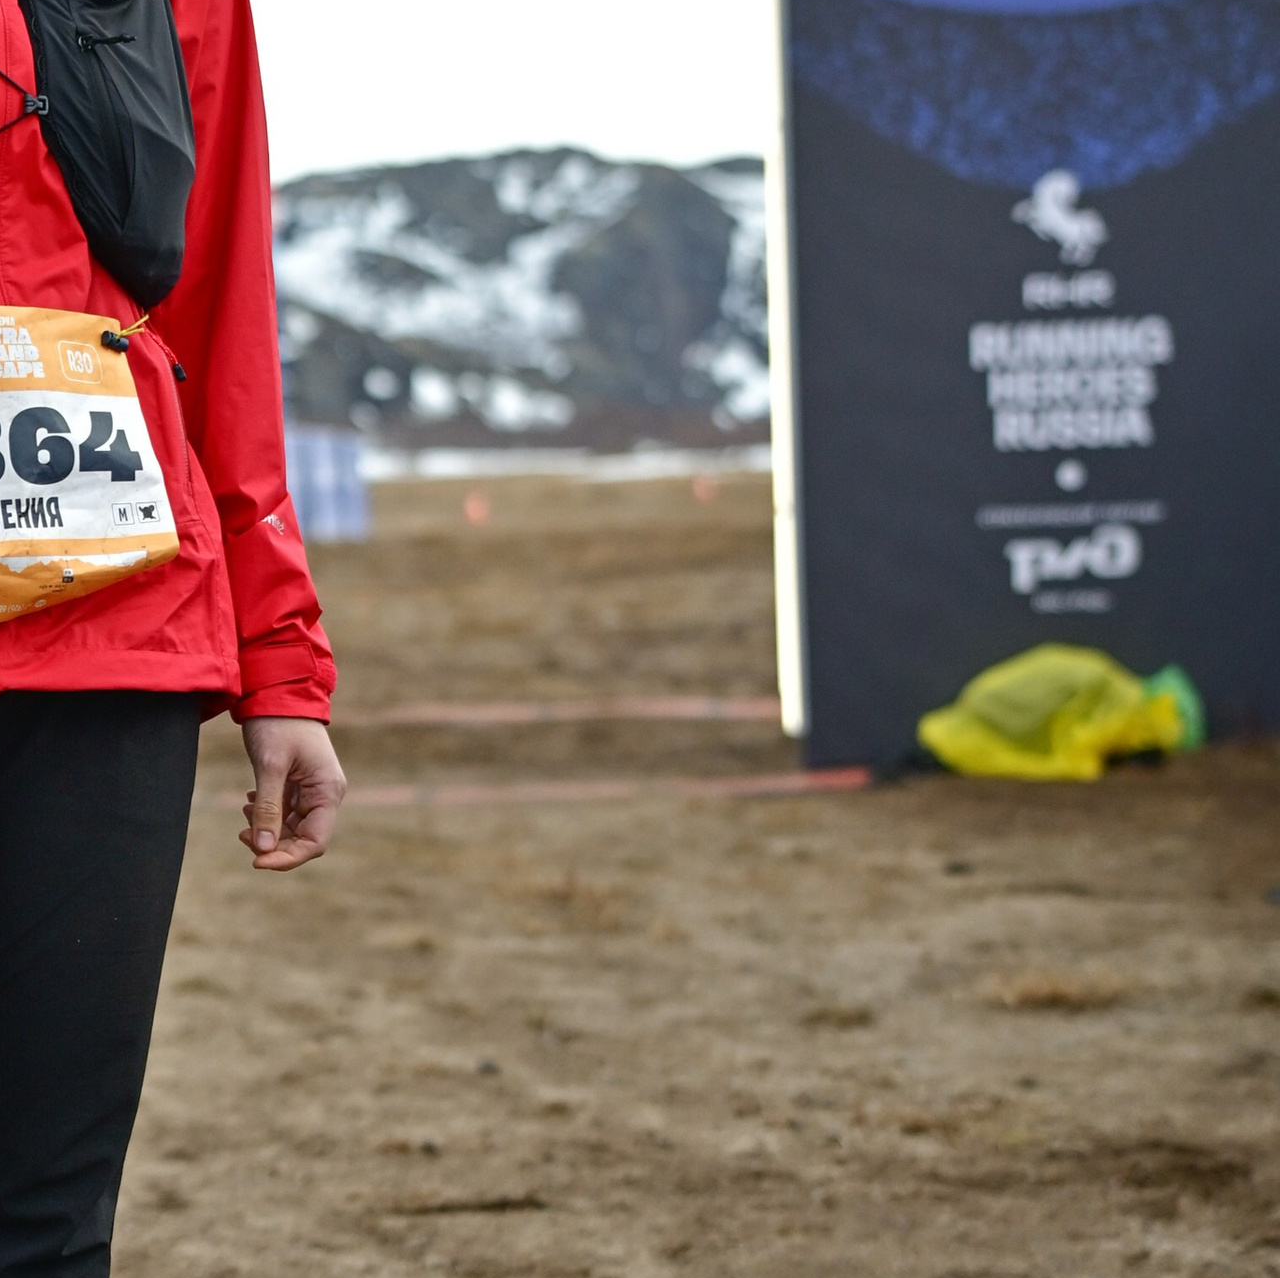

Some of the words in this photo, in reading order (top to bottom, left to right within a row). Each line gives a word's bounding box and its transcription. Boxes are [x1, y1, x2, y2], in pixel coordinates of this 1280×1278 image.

[66, 349, 93, 374] R30
[968, 315, 1175, 370] RUNNING
[987, 365, 1157, 411] HEROES
[993, 408, 1154, 451] RUSSIA
